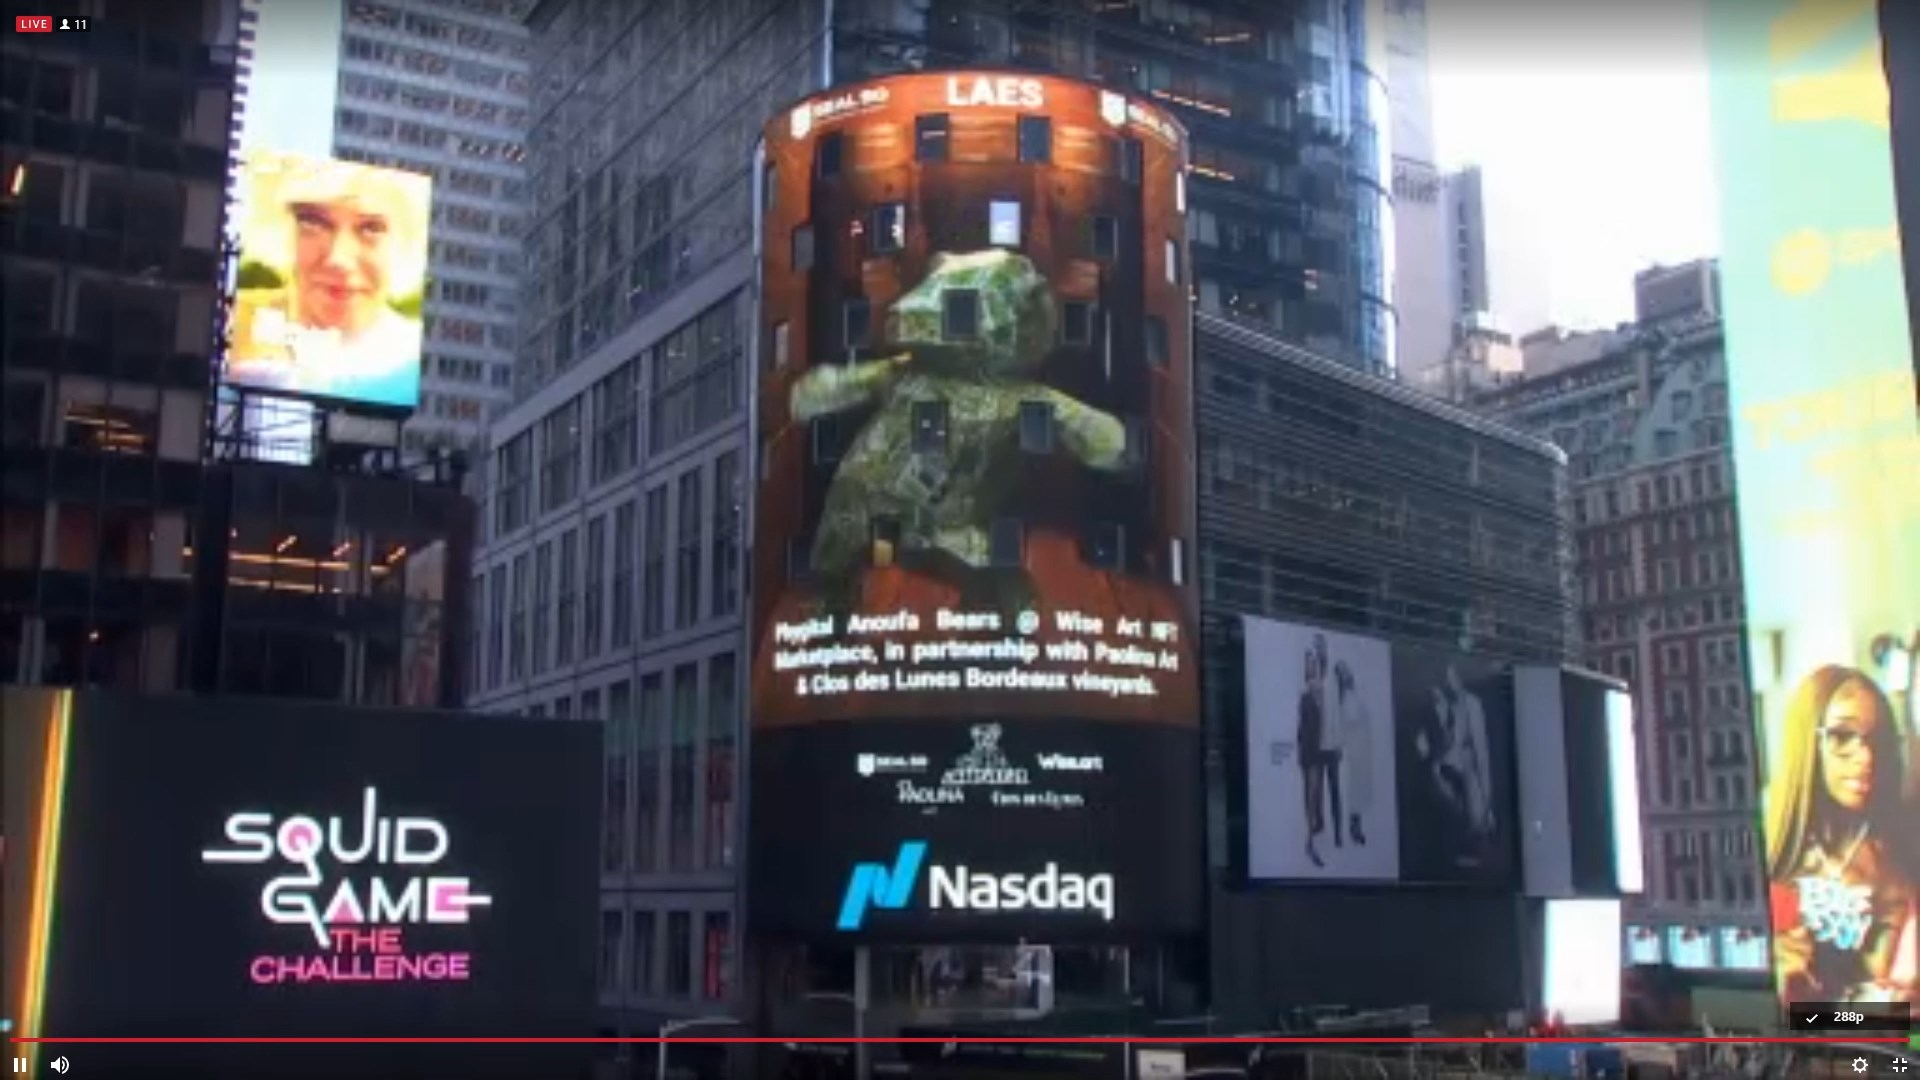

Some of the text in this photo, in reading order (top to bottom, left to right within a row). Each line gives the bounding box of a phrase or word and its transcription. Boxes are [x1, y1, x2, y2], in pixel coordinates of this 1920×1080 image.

[946, 76, 1044, 107] LAES
[847, 608, 920, 634] Anoufa
[937, 607, 1001, 631] Bears
[1016, 609, 1040, 635] @
[1055, 610, 1104, 635] Wise
[1116, 615, 1143, 638] Art
[884, 639, 905, 661] in
[911, 636, 1040, 665] partnership
[1045, 639, 1089, 662] with
[812, 670, 849, 695] Clos
[854, 668, 890, 691] des
[895, 667, 961, 691] Lunes
[966, 666, 1067, 689] Bordeaux
[201, 786, 449, 866] SQUID
[928, 861, 1115, 921] Nasdaq
[261, 876, 492, 948] GAME
[330, 927, 402, 953] THE
[250, 953, 470, 983] CHALLENGE
